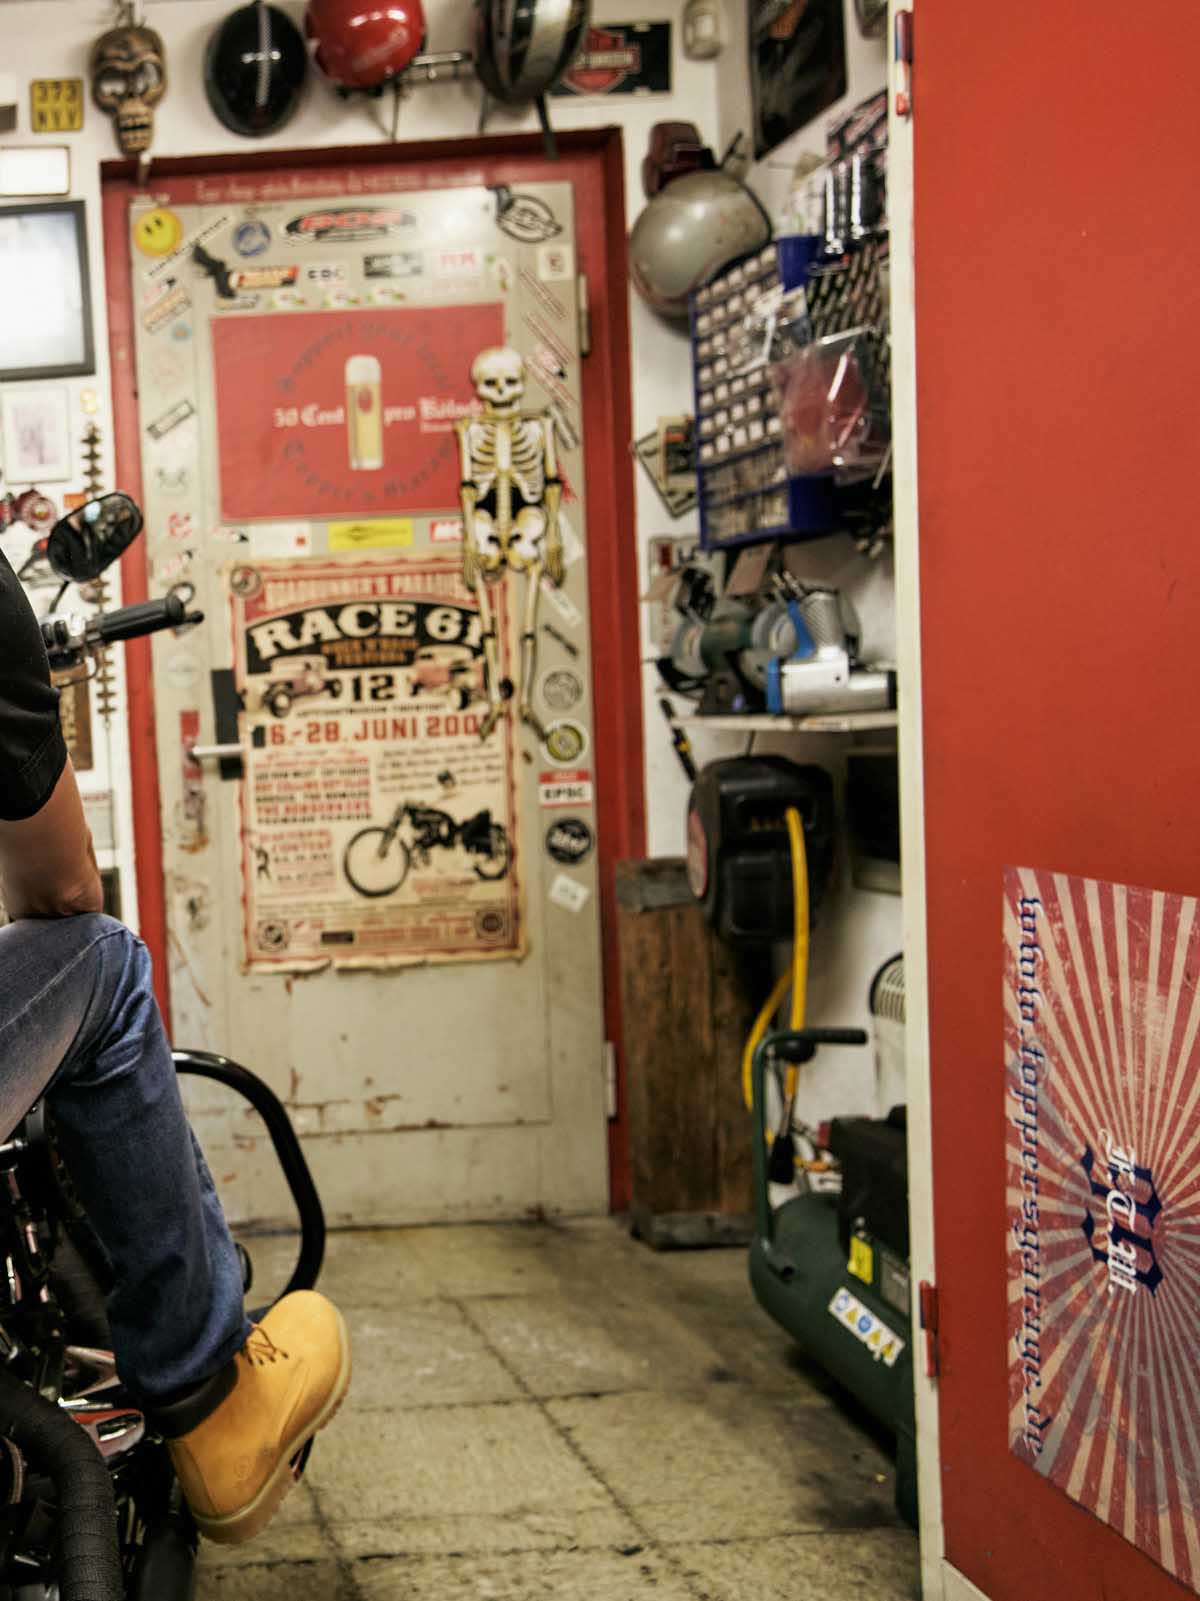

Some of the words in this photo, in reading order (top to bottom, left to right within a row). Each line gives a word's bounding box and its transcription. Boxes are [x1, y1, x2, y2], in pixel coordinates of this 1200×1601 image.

[250, 602, 417, 660] RACE
[351, 673, 396, 702] 12
[269, 720, 350, 747] 6.-28.
[353, 716, 419, 744] JUNI
[425, 713, 497, 740] 200
[1011, 895, 1052, 1457] www.toppersgarage.de
